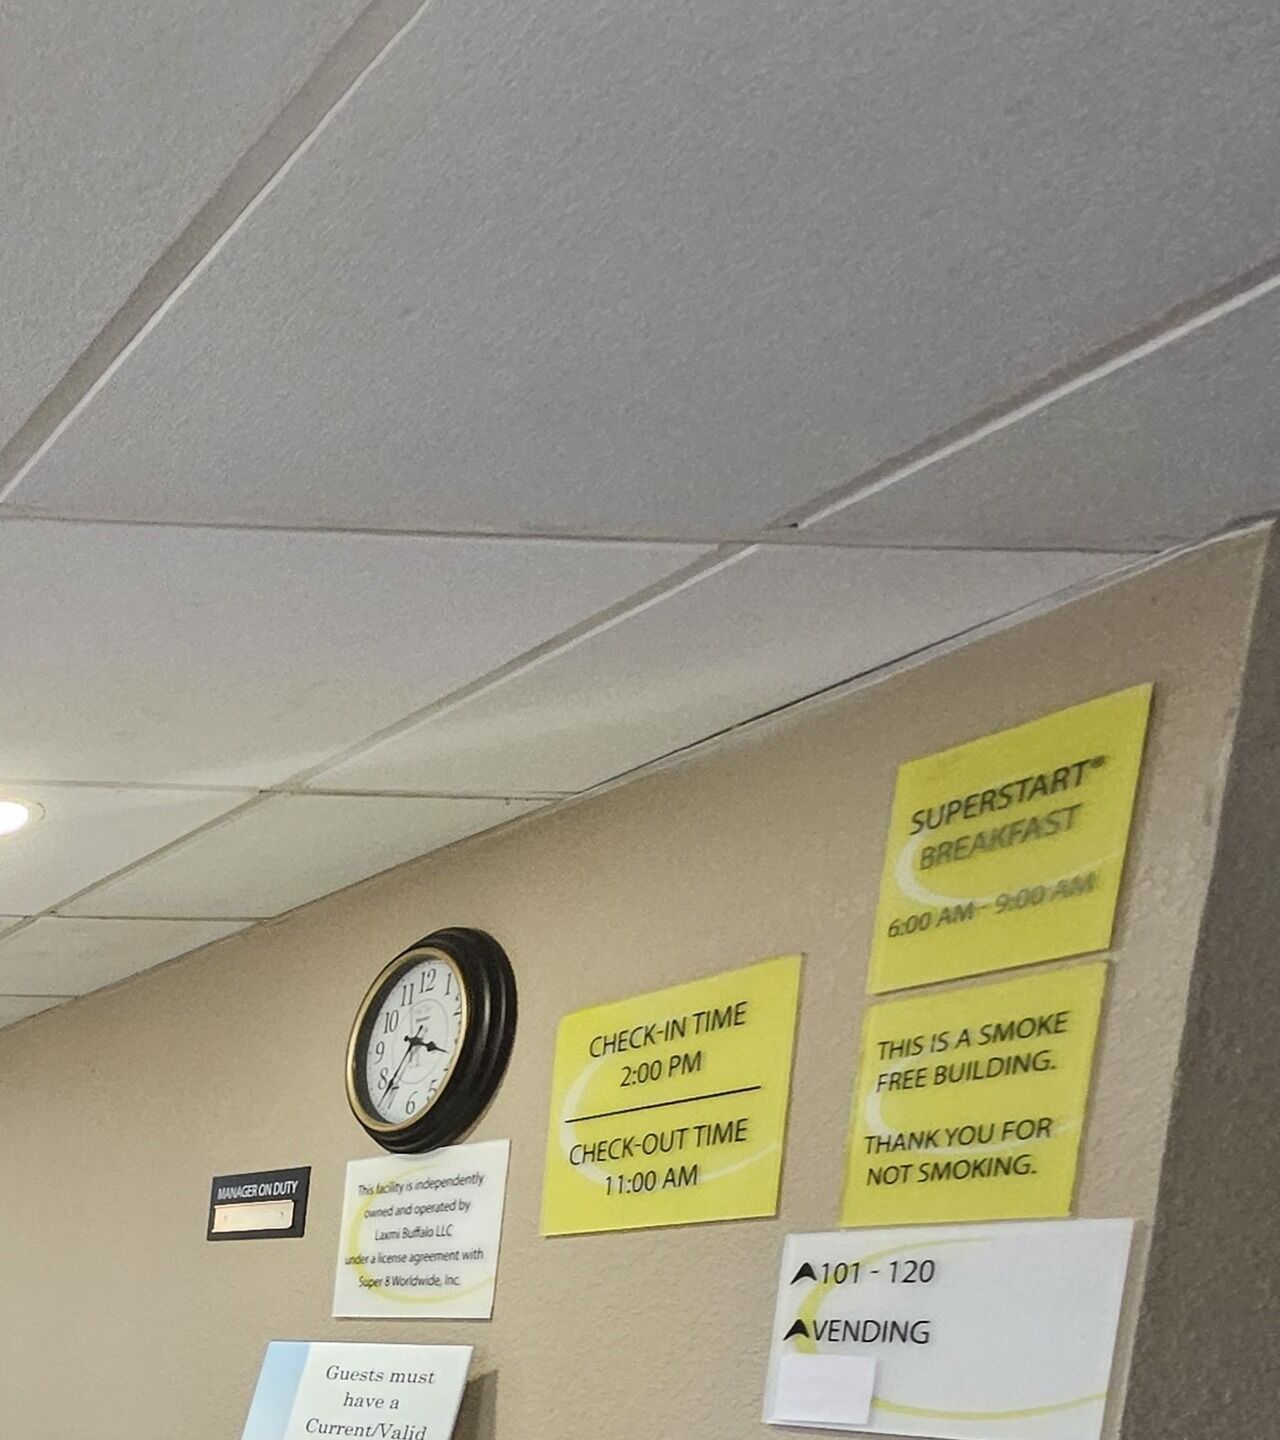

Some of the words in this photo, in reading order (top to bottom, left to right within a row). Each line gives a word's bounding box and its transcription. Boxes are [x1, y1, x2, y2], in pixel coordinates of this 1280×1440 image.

[919, 803, 1084, 871] BREAKFAST
[888, 911, 932, 938] 6:00
[936, 902, 975, 927] AM
[995, 885, 1047, 914] 9:00
[1051, 871, 1096, 898] AM
[419, 968, 436, 993] 12
[444, 973, 452, 995] 1
[400, 983, 415, 1007] 11
[384, 1009, 399, 1033] 10
[589, 1016, 687, 1058] CHECK-IN
[692, 1001, 748, 1034] TIME
[877, 1035, 925, 1060] THIS
[930, 1031, 949, 1053] IS
[954, 1029, 971, 1049] A
[978, 1010, 1070, 1045] SMOKE
[374, 1041, 385, 1065] 9
[377, 1067, 388, 1090] 8
[620, 1060, 662, 1087] 2:00
[668, 1050, 701, 1077] PM
[876, 1067, 927, 1093] FREE
[933, 1050, 1057, 1086] BUILDING.
[405, 1091, 418, 1115] 6
[569, 1128, 689, 1166] CHECK-OUT
[693, 1118, 748, 1147] TIME
[864, 1129, 941, 1154] THANK
[945, 1123, 995, 1147] YOU
[1001, 1117, 1054, 1141] FOR
[605, 1170, 656, 1195] 11:00
[662, 1164, 698, 1189] AM
[866, 1164, 913, 1186] NOT
[917, 1154, 1037, 1183] SMOKING.
[217, 1184, 258, 1200] MANAGER
[258, 1182, 272, 1197] ON
[273, 1180, 299, 1196] DUTY
[358, 1185, 374, 1196] This
[375, 1181, 404, 1195] facility
[406, 1181, 413, 1191] is
[414, 1172, 485, 1190] independently
[364, 1207, 393, 1219] owned
[394, 1203, 412, 1216] and
[414, 1200, 455, 1216] operated
[459, 1198, 471, 1214] by
[375, 1229, 400, 1241] Laxmi
[402, 1226, 433, 1239] Buffalo
[436, 1224, 454, 1237] LLC
[345, 1254, 368, 1265] under
[370, 1256, 376, 1264] a
[377, 1252, 407, 1263] license
[409, 1251, 459, 1266] agreement
[461, 1248, 484, 1260] with
[359, 1276, 382, 1289] Super
[385, 1276, 389, 1286] 8
[821, 1259, 860, 1284] 101
[889, 1259, 936, 1284] 120
[813, 1319, 931, 1344] VENDING
[326, 1365, 384, 1382] Guests
[389, 1369, 435, 1385] must
[343, 1392, 384, 1409] have
[389, 1399, 399, 1410] a
